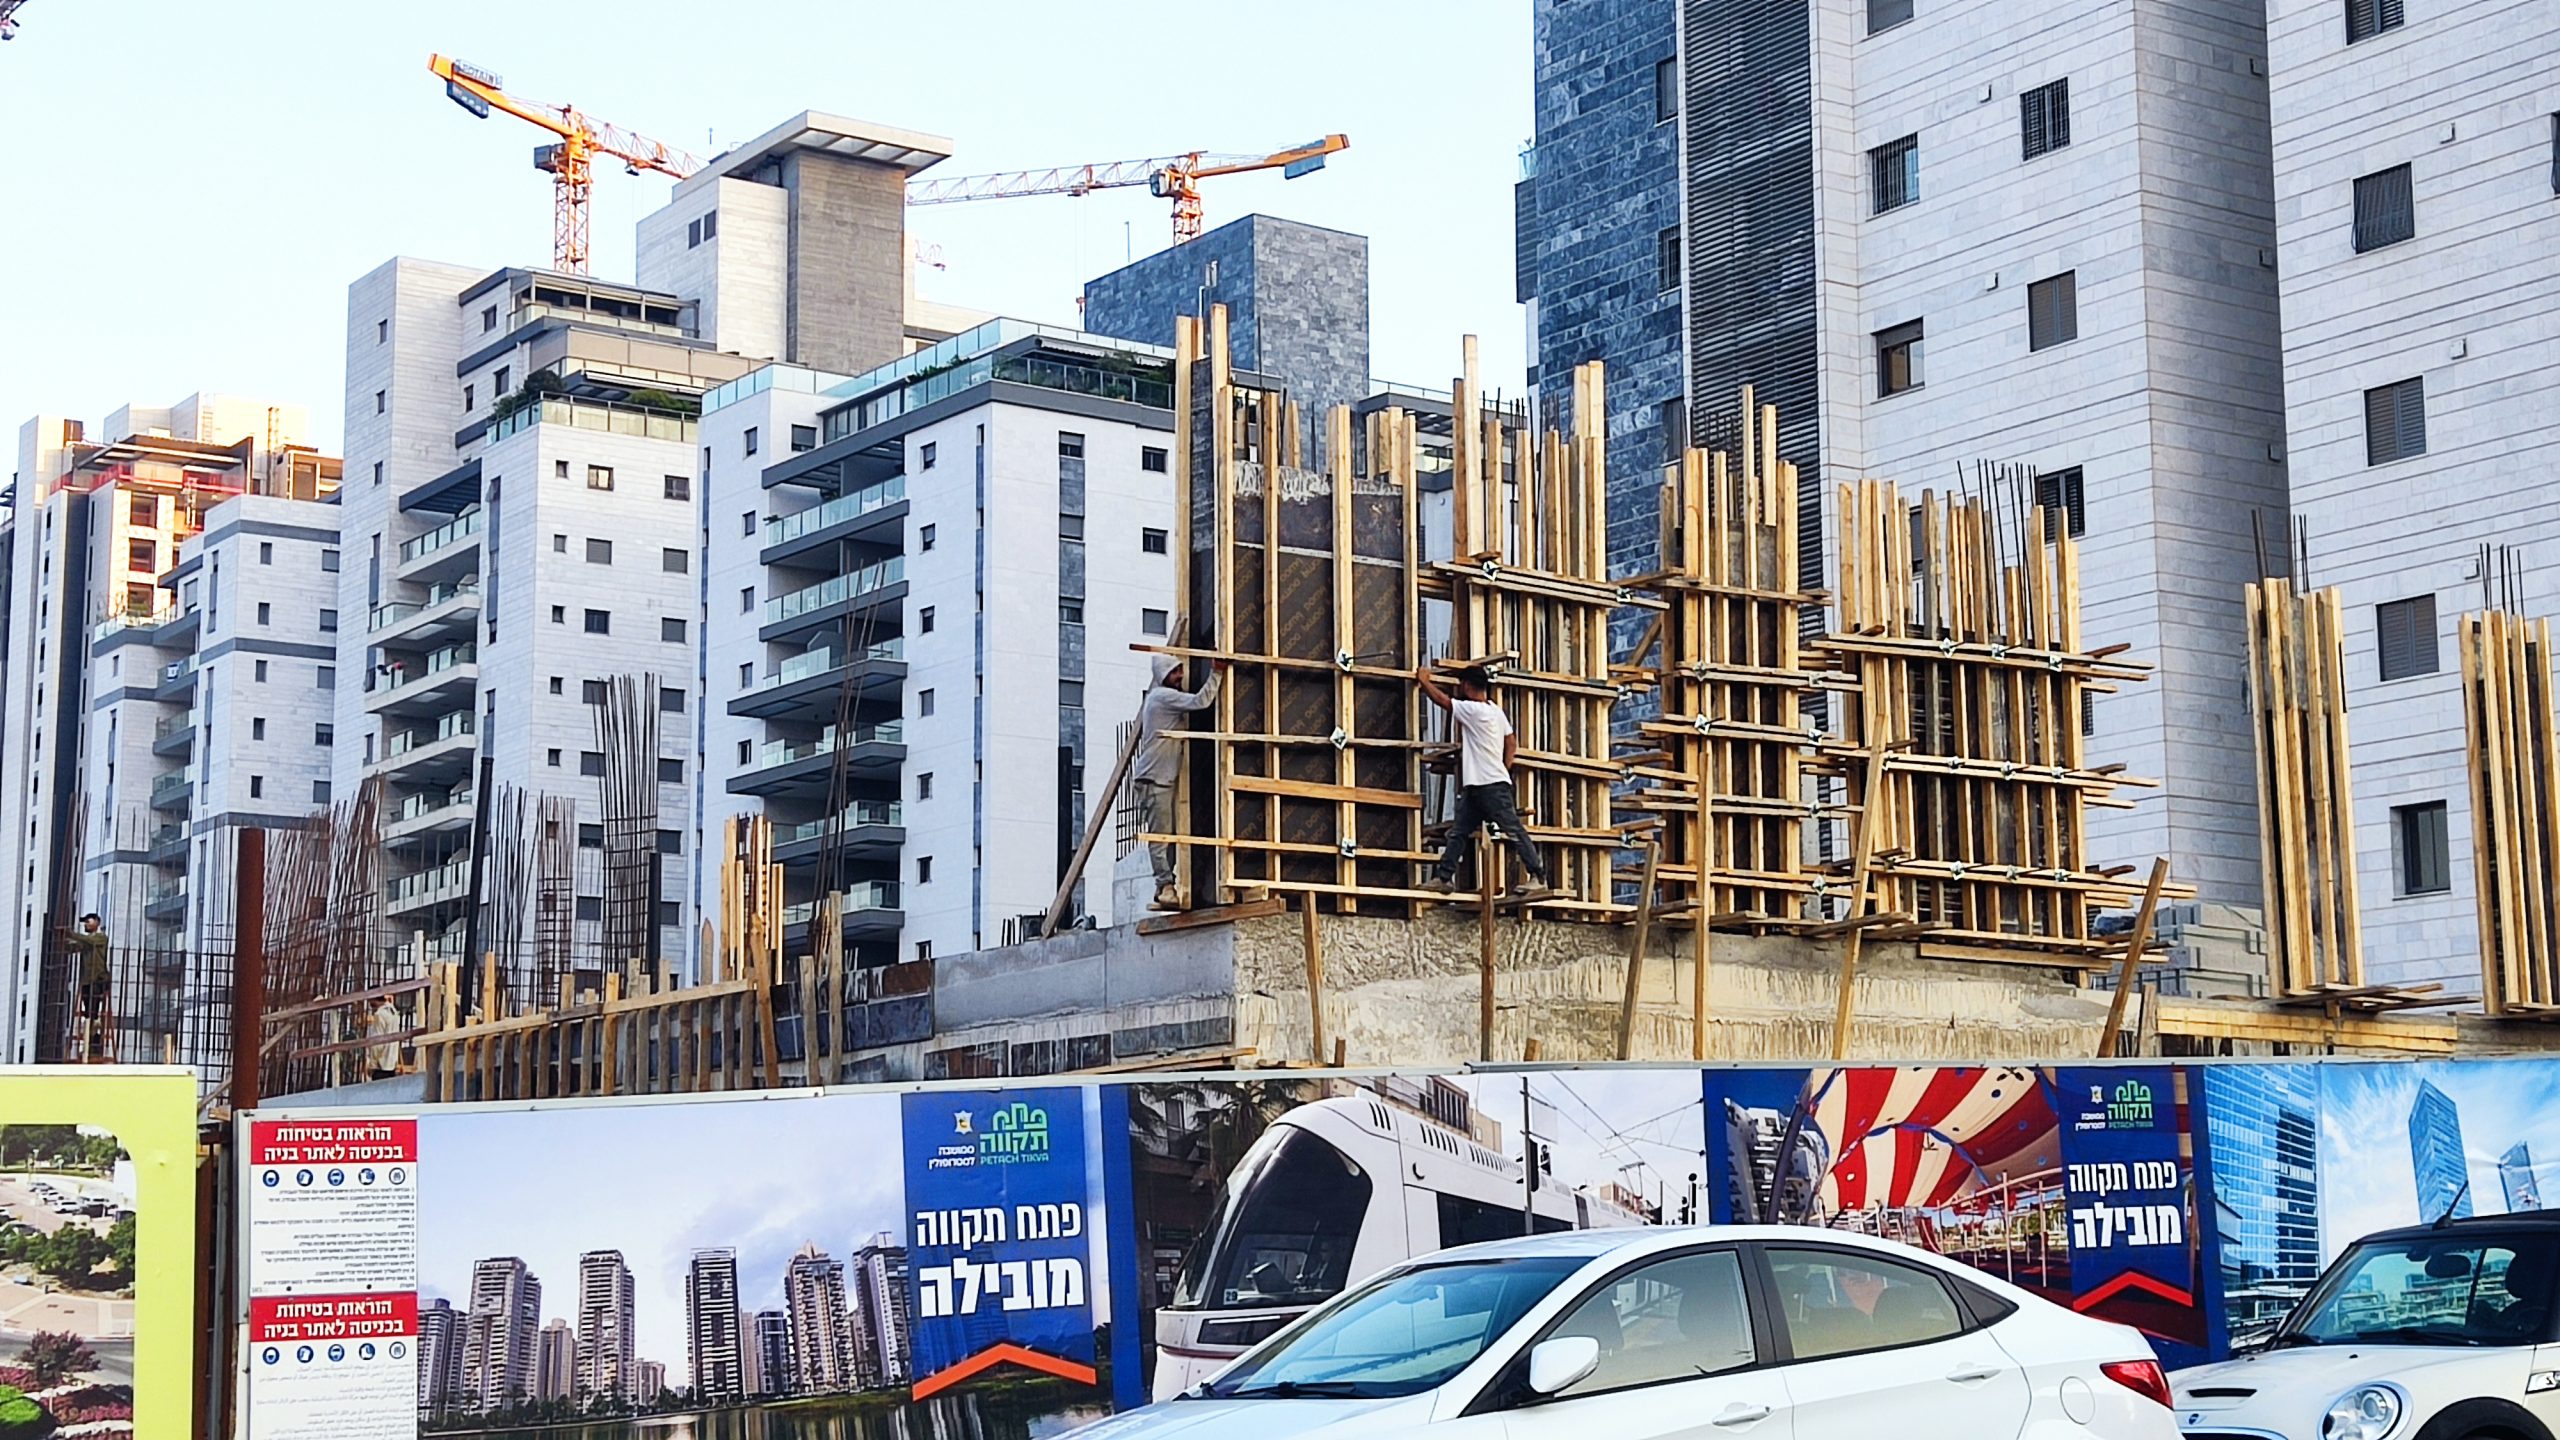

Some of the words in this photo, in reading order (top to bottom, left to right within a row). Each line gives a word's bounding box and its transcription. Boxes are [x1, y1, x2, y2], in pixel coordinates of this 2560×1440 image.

[2107, 1103, 2153, 1121] תקווה
[276, 1128, 333, 1142] בטיחות
[336, 1127, 392, 1142] הוראות
[979, 1131, 1049, 1154] תקווה
[264, 1147, 299, 1162] בניה
[302, 1144, 346, 1161] לאתר
[349, 1145, 404, 1160] בכניסה
[980, 1153, 1019, 1165] PETACH
[1021, 1152, 1049, 1163] TIKVA
[2068, 1163, 2129, 1197] תקווה
[2133, 1161, 2178, 1190] פתח
[916, 1207, 1007, 1251] תקווה
[1016, 1203, 1082, 1240] פתח
[2072, 1201, 2183, 1249] מובילה
[919, 1257, 1085, 1318] מובילה
[276, 1302, 334, 1318] בטיחות
[336, 1300, 392, 1315] הוראות
[264, 1324, 299, 1339] בניה
[302, 1319, 346, 1337] לאתר
[349, 1319, 405, 1334] בכניסה
